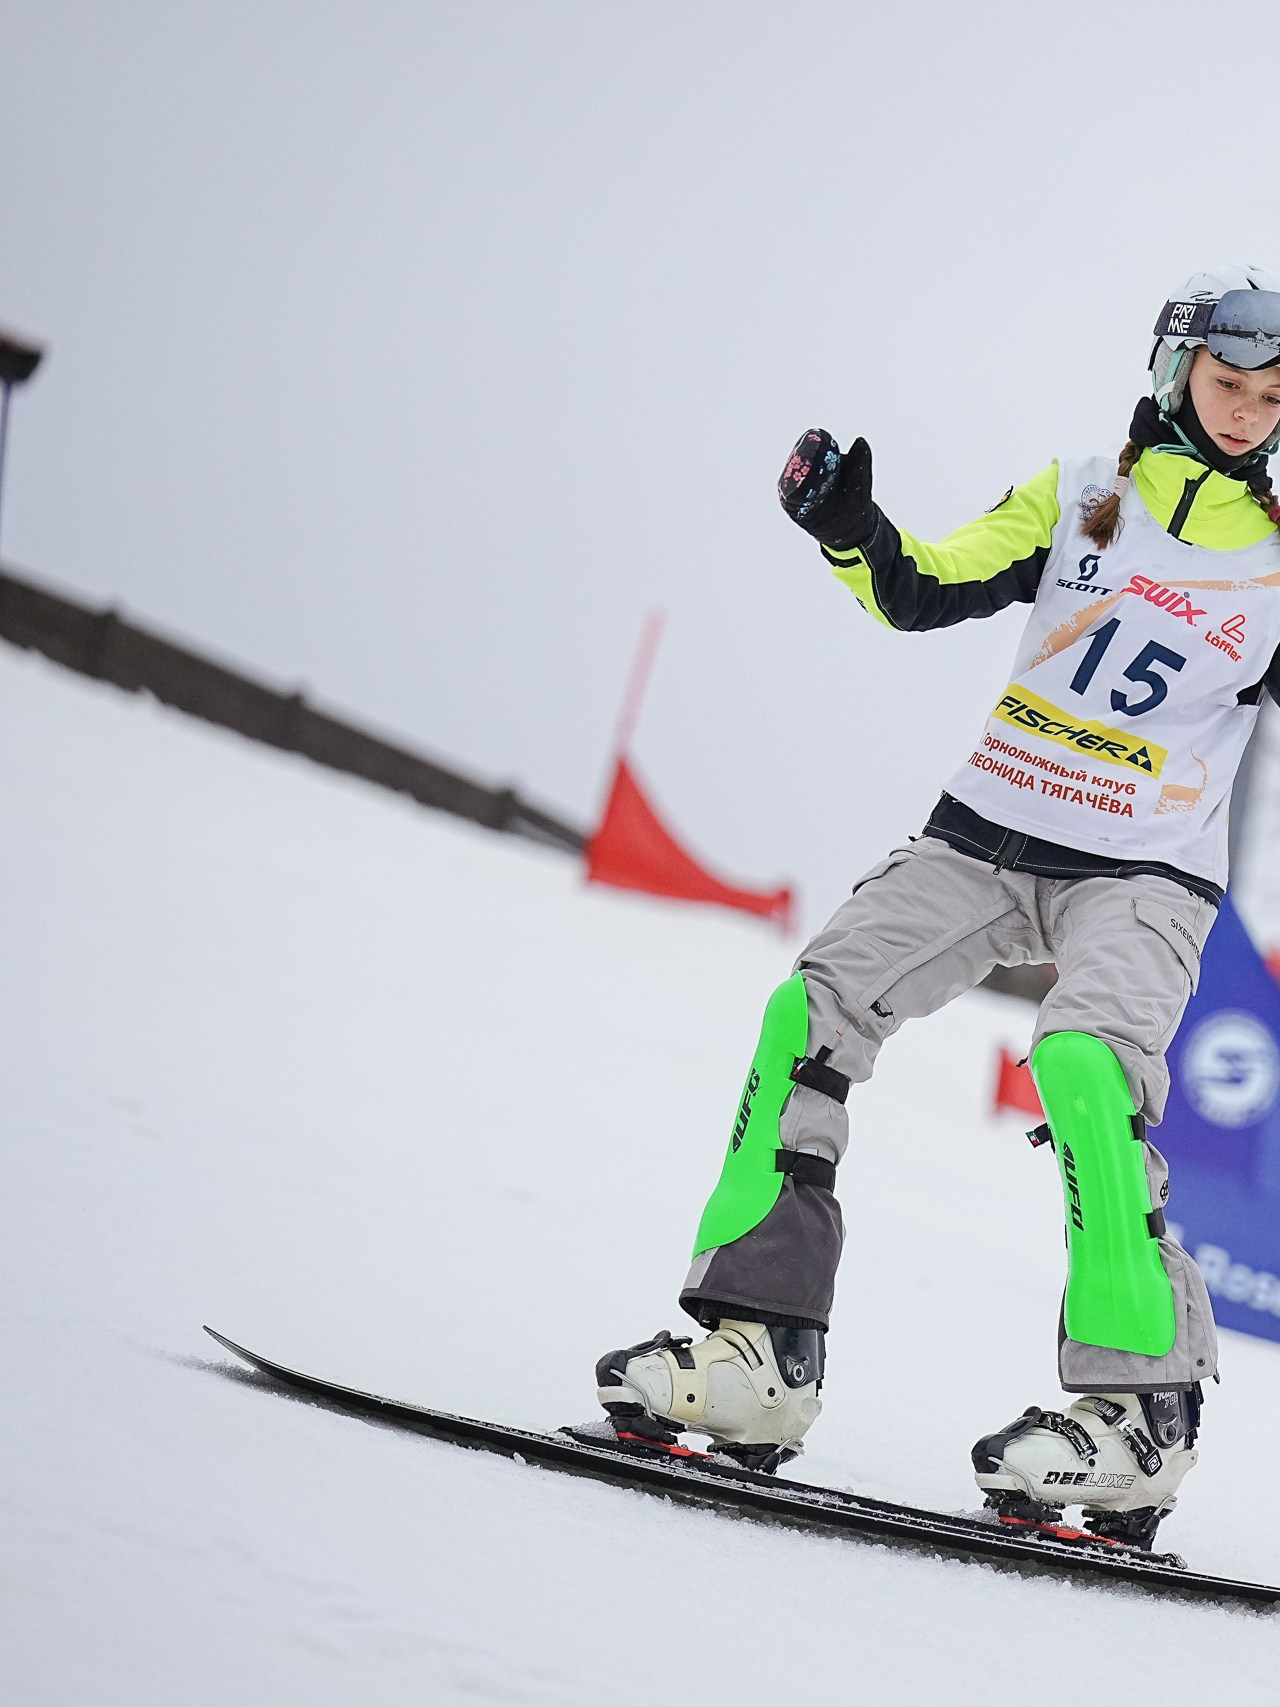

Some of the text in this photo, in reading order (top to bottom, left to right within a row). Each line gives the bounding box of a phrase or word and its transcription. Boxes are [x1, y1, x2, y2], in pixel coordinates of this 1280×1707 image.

[1056, 578, 1113, 596] SCOTT
[1068, 617, 1187, 717] 15
[995, 695, 1129, 759] FISCHER
[967, 751, 1133, 818] ЛЕОНИДА ТЯГАЧЁВА
[1091, 775, 1137, 796] клуб
[1042, 1471, 1137, 1489] DEELUXE
